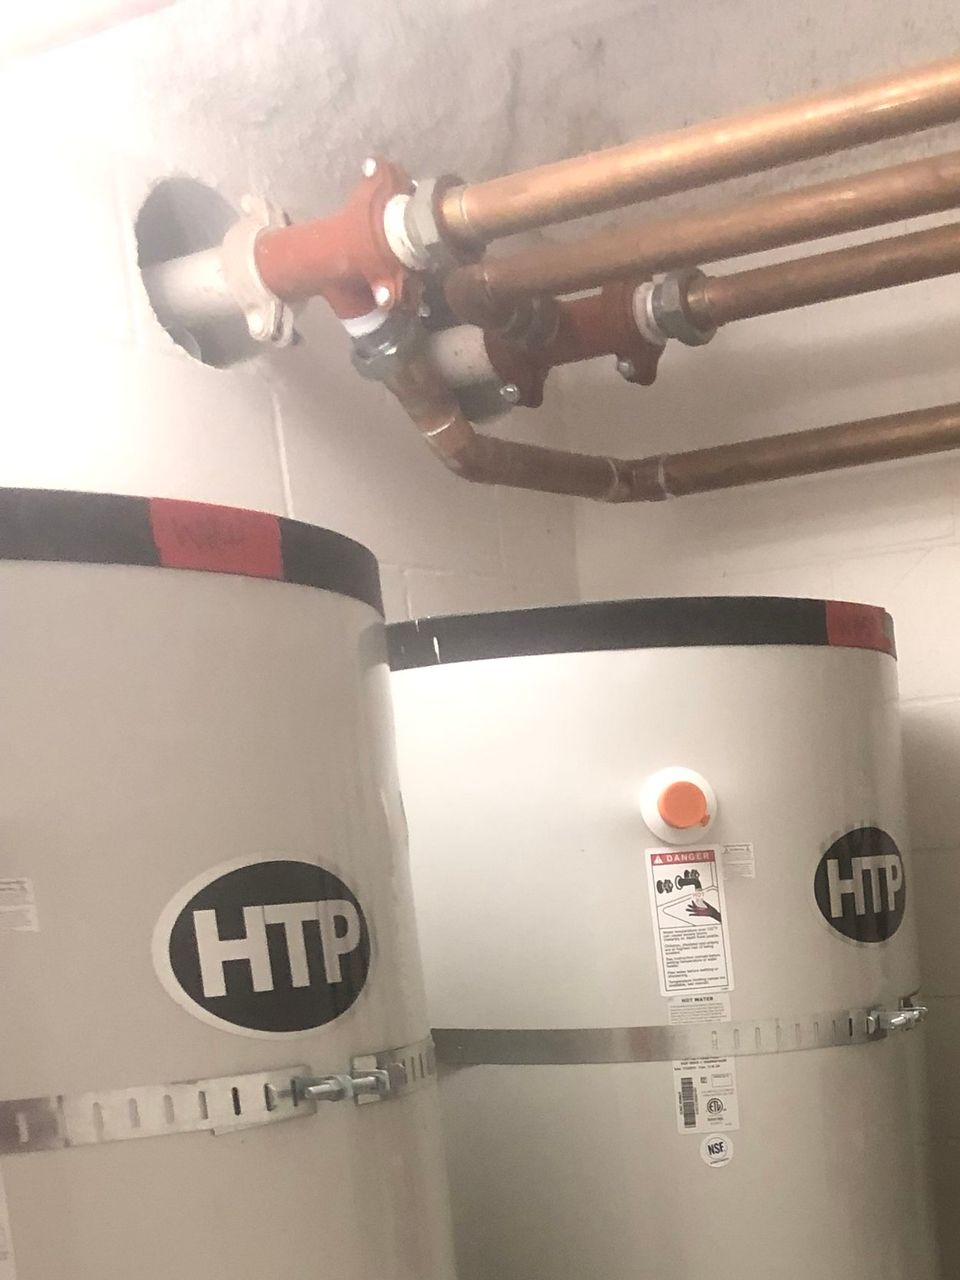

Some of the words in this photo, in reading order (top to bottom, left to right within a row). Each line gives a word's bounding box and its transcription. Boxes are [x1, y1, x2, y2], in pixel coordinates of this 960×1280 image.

[666, 852, 710, 862] DANGER
[827, 855, 902, 918] HTP
[193, 899, 361, 998] HTP
[707, 1141, 724, 1155] NSF
